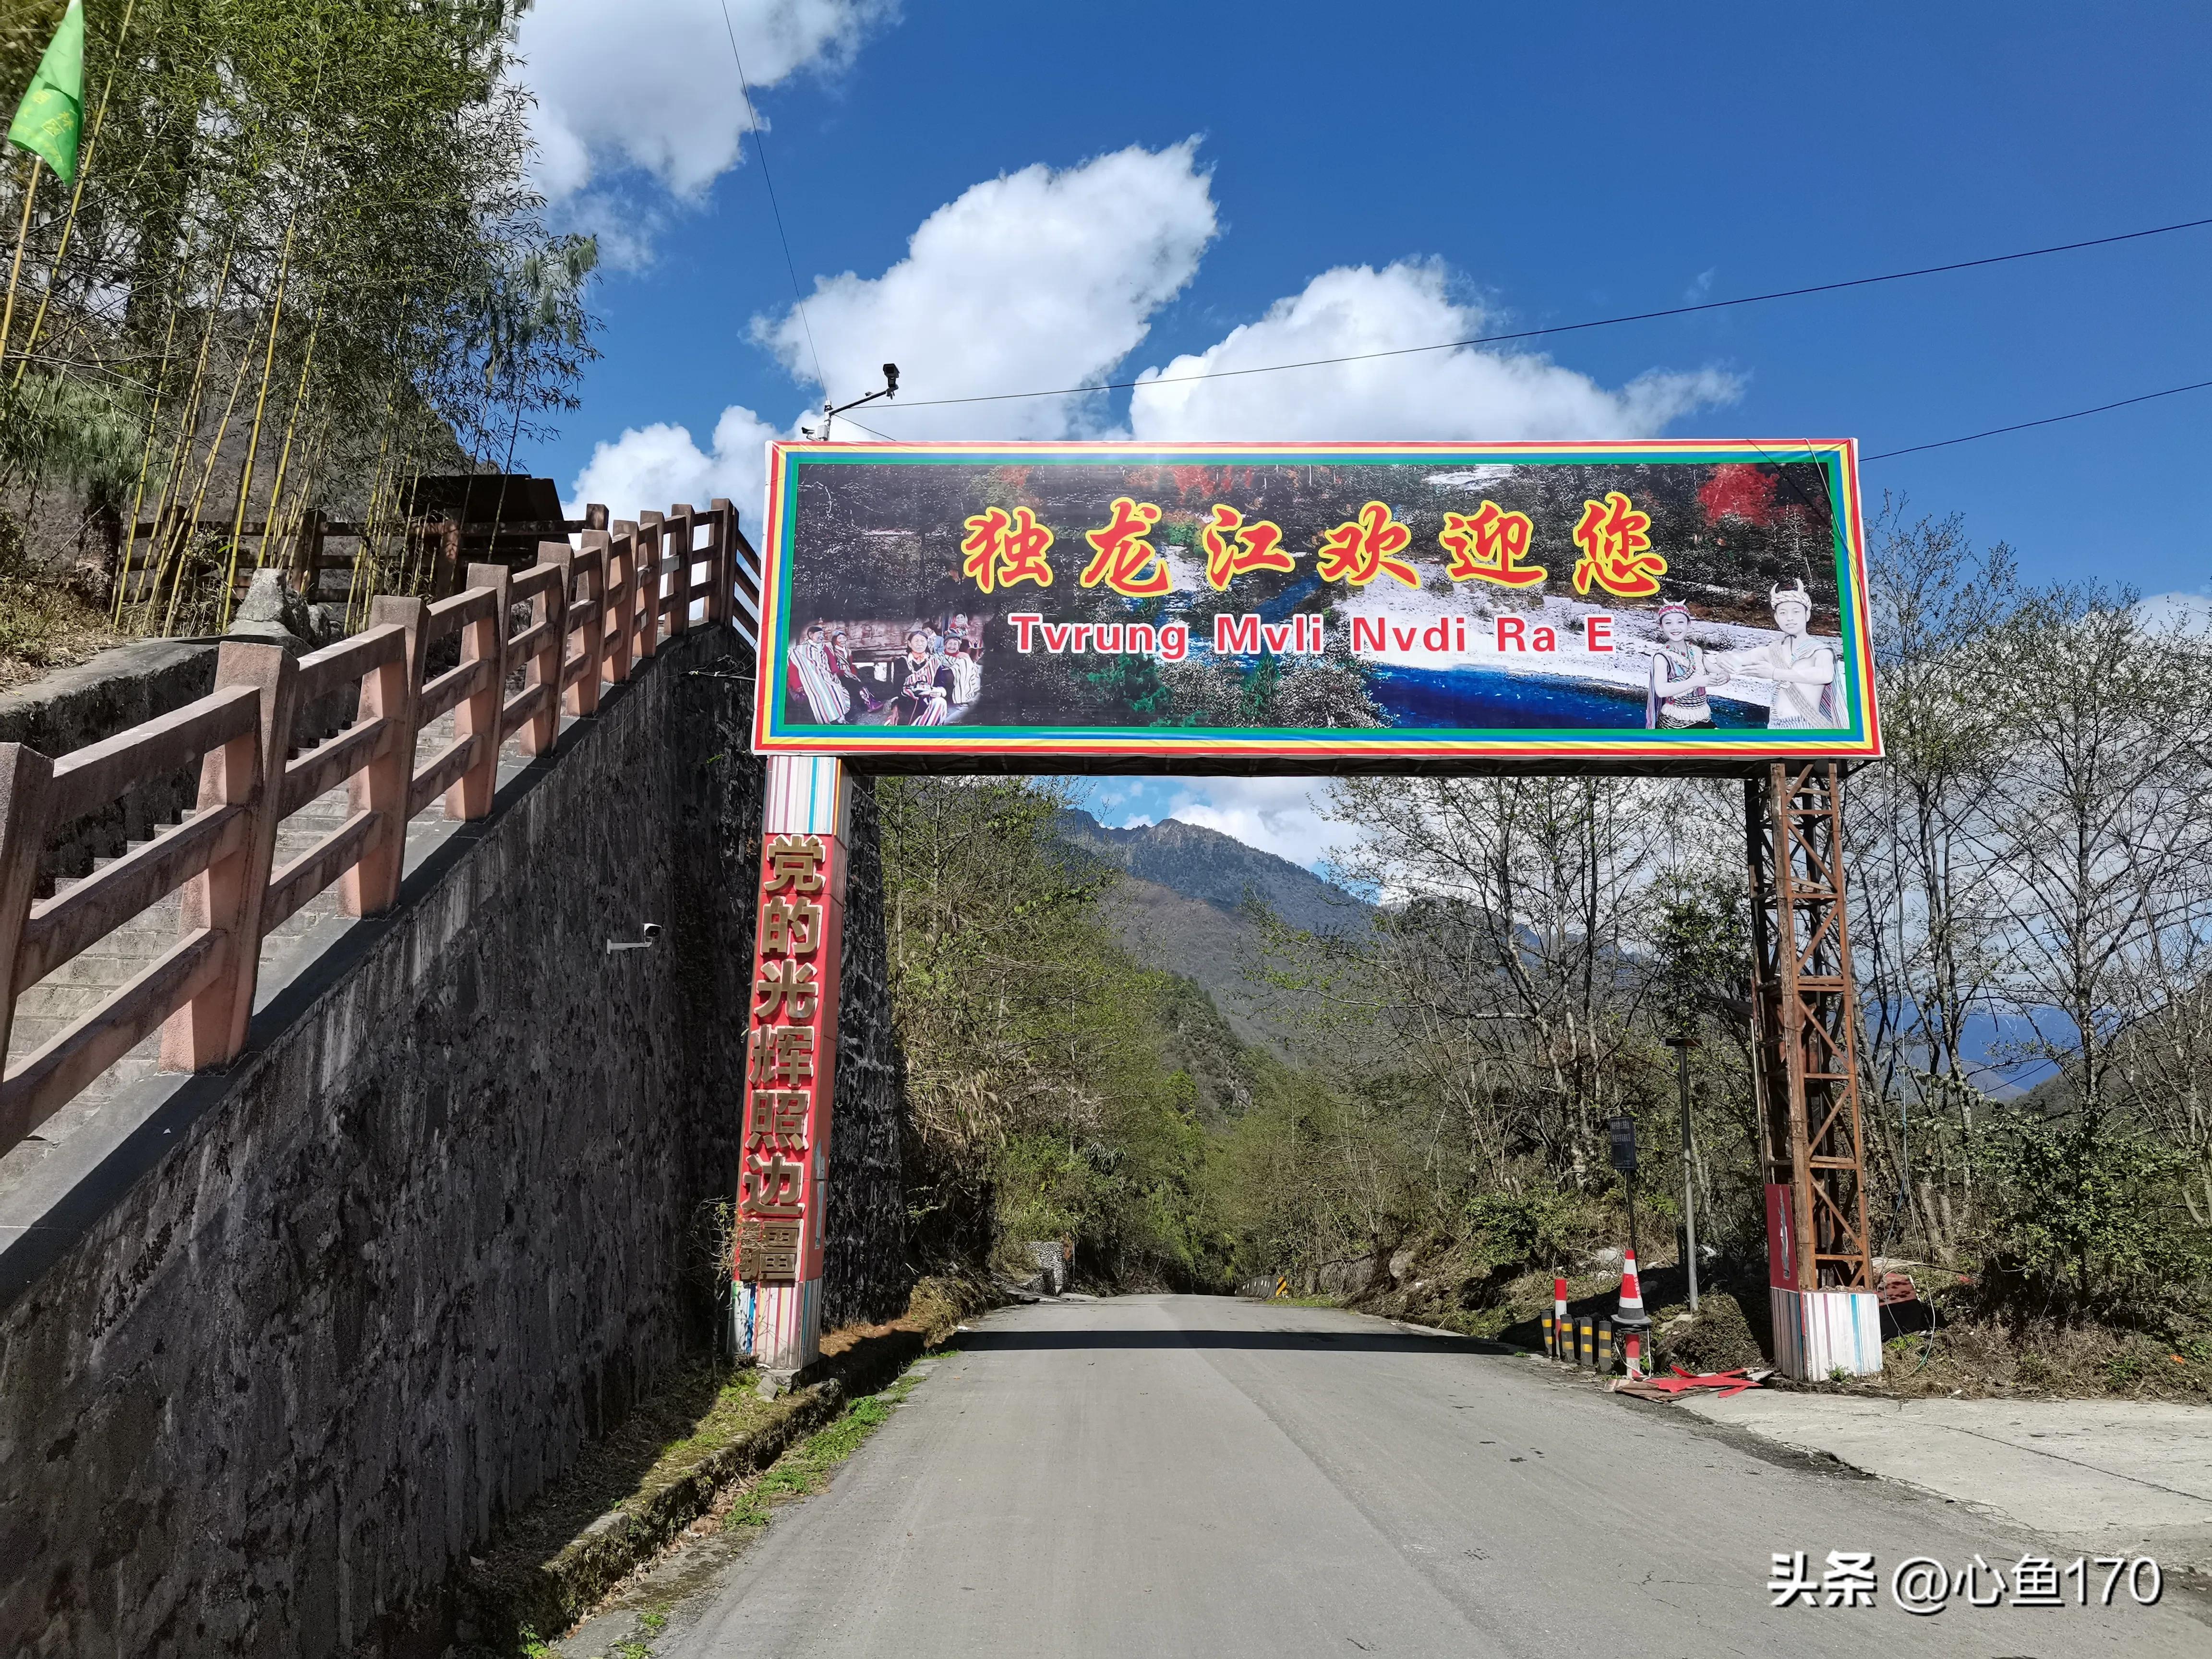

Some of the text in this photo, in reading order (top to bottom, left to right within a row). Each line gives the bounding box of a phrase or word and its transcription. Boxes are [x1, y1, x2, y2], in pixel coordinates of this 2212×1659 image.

[962, 492, 1668, 597] 独龙江欢迎您
[1010, 614, 1614, 661] Tvrung Mvli Nvdi Ra E
[738, 834, 826, 1282] 党的光辉照边疆
